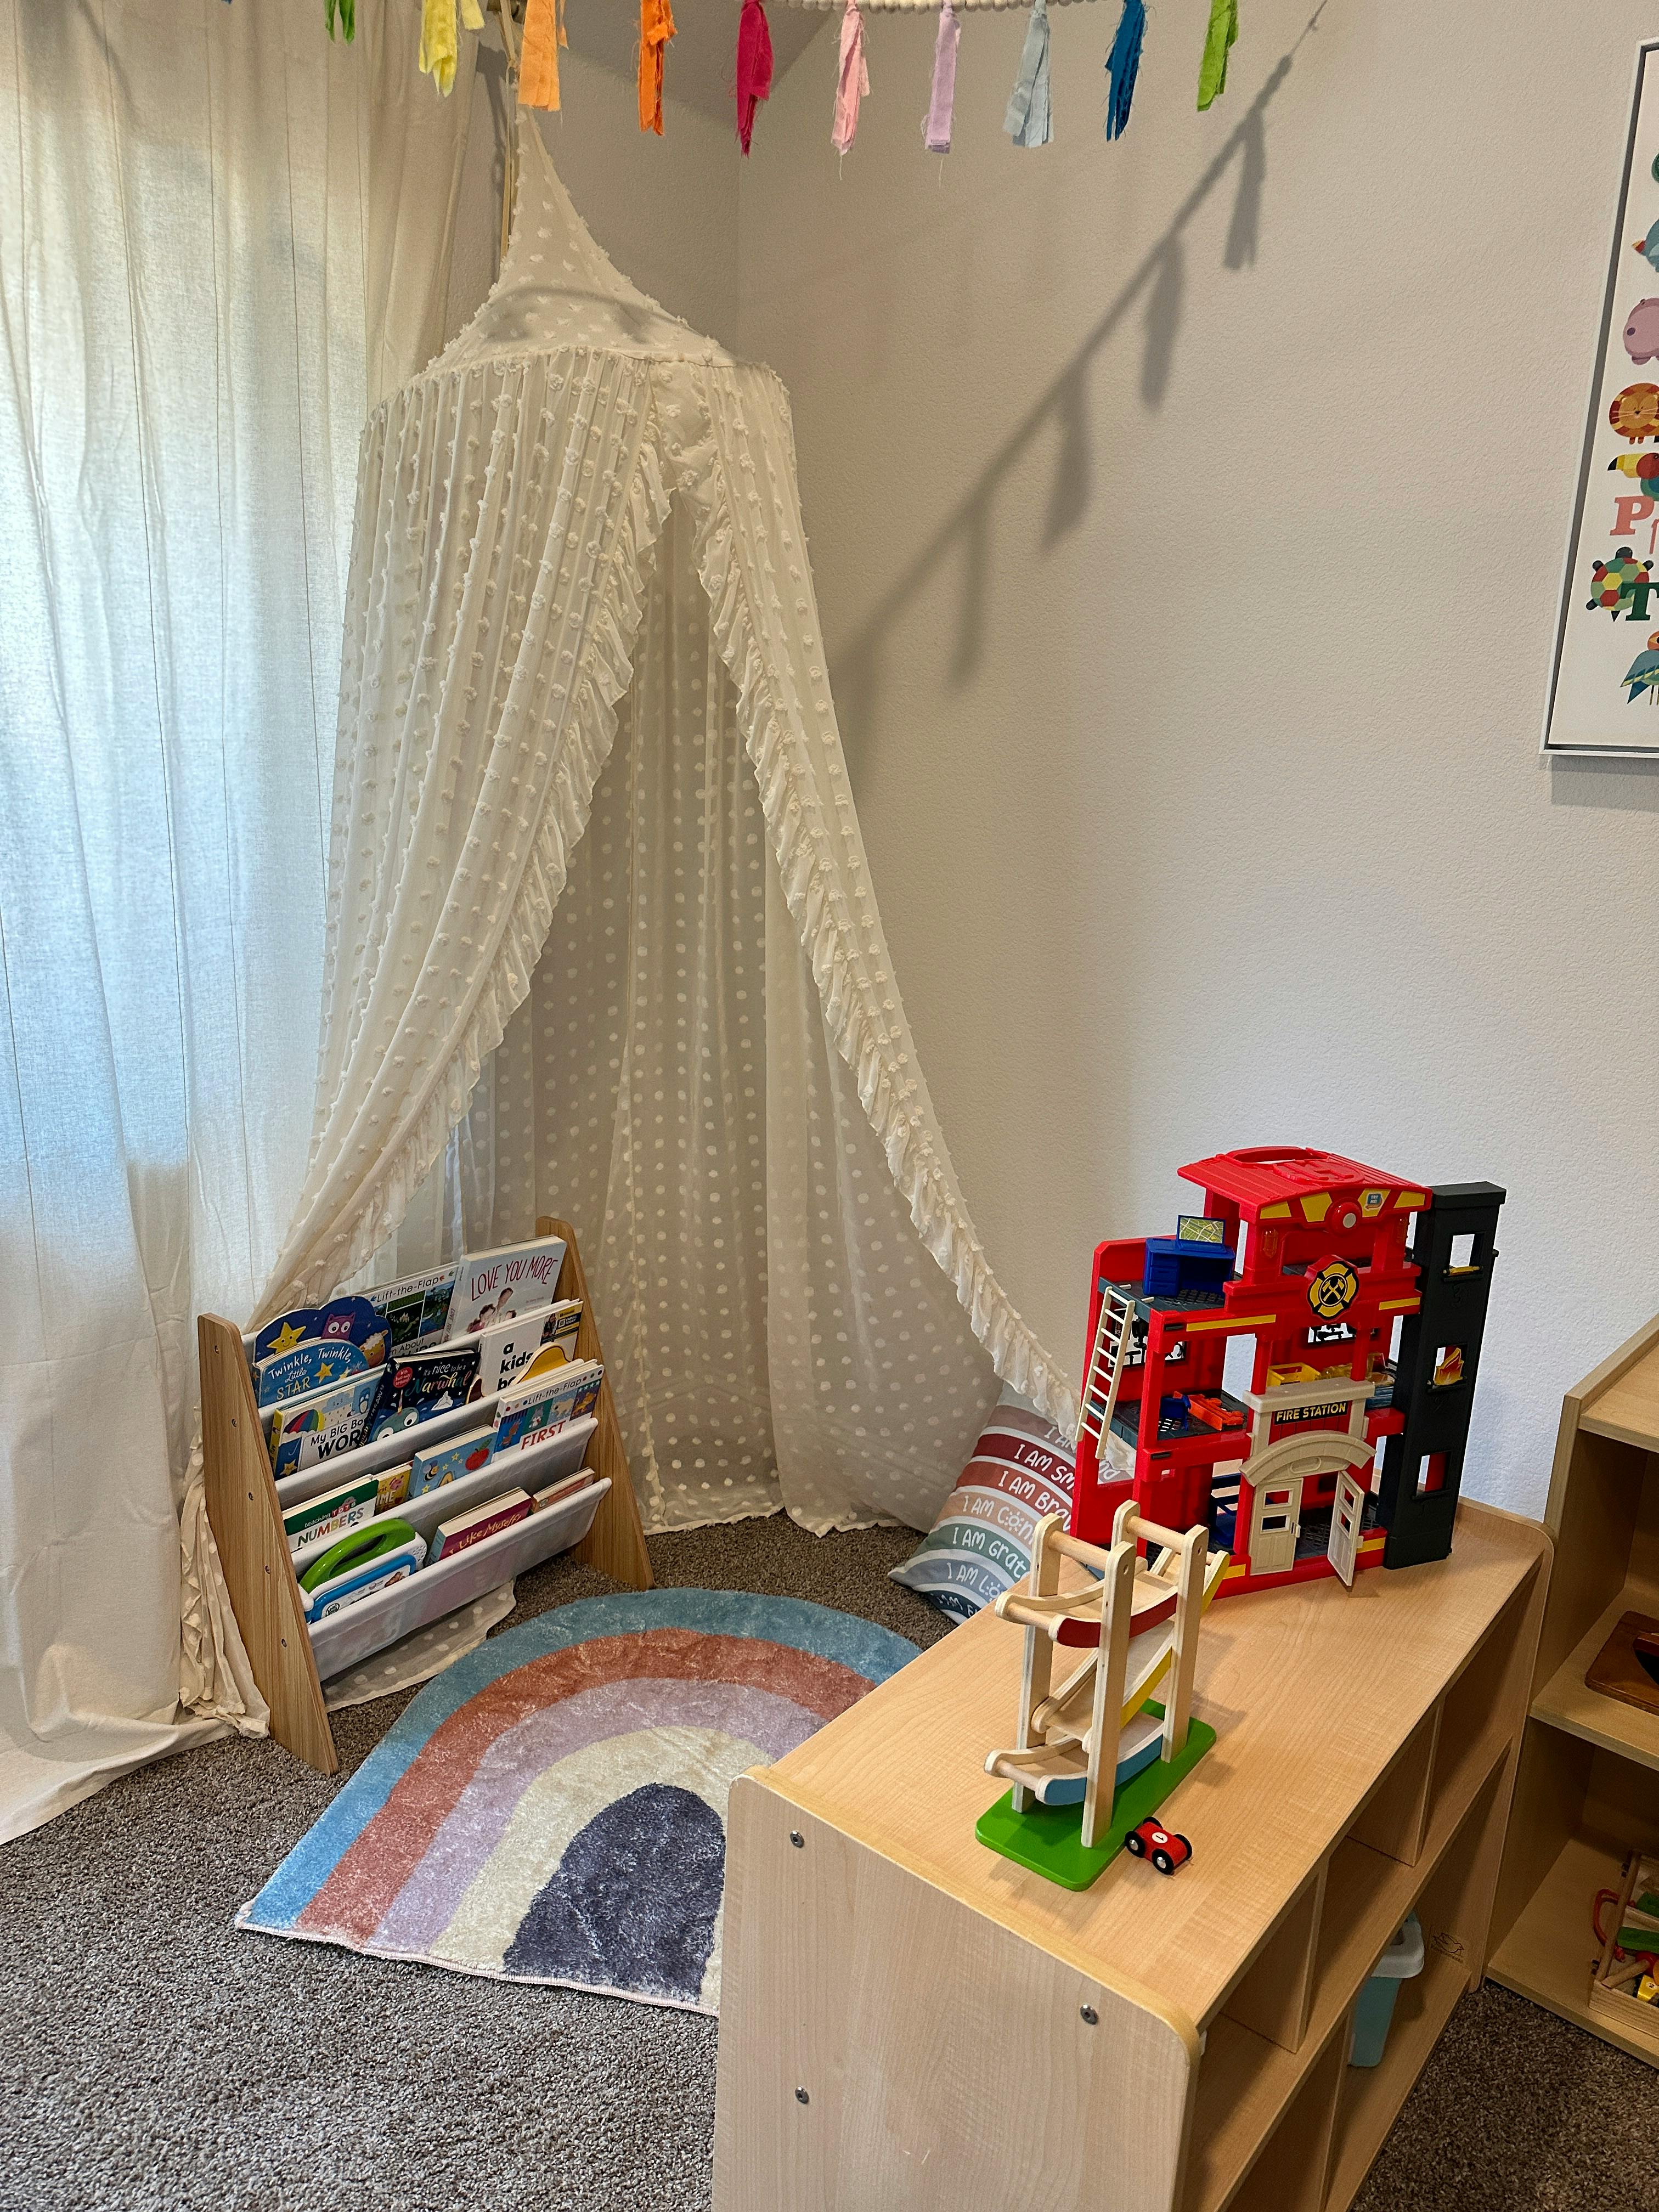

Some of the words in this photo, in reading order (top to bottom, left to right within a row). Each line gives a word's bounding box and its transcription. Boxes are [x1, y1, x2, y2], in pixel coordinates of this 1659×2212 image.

[1610, 495, 1655, 536] P
[1620, 582, 1659, 610] T
[377, 1277, 439, 1303] Lift-the-Flap
[471, 1264, 503, 1301] LOVE
[504, 1259, 528, 1284] YOU
[525, 1255, 558, 1284] MORE
[399, 1337, 424, 1353] About
[503, 1342, 515, 1355] a
[268, 1353, 312, 1380] Twinkle,
[318, 1346, 352, 1363] Twinkle,
[284, 1367, 308, 1383] Little
[432, 1362, 451, 1375] nice
[276, 1376, 311, 1400] STAR
[404, 1370, 472, 1397] Narwhal
[528, 1378, 582, 1405] Lift-the-Flap
[1276, 1409, 1300, 1422] FIRE
[1303, 1402, 1346, 1418] STATION
[311, 1434, 326, 1446] My
[330, 1423, 347, 1438] BIG
[351, 1419, 365, 1430] Bo
[318, 1429, 361, 1460] WOR
[521, 1420, 567, 1450] FIRST
[1014, 1444, 1025, 1459] I
[1024, 1450, 1053, 1471] AM
[376, 1491, 396, 1505] IME
[998, 1470, 1008, 1487] I
[1008, 1476, 1036, 1499] AM
[304, 1513, 331, 1528] teaching
[331, 1502, 357, 1517] TOTS
[963, 1495, 969, 1512] I
[970, 1497, 995, 1517] AM
[298, 1507, 364, 1547] NUMBERS
[459, 1531, 483, 1549] Like
[483, 1514, 522, 1537] Myself!
[952, 1527, 959, 1544] I
[962, 1529, 986, 1550] AM
[947, 1562, 953, 1579] I
[956, 1565, 979, 1585] AM
